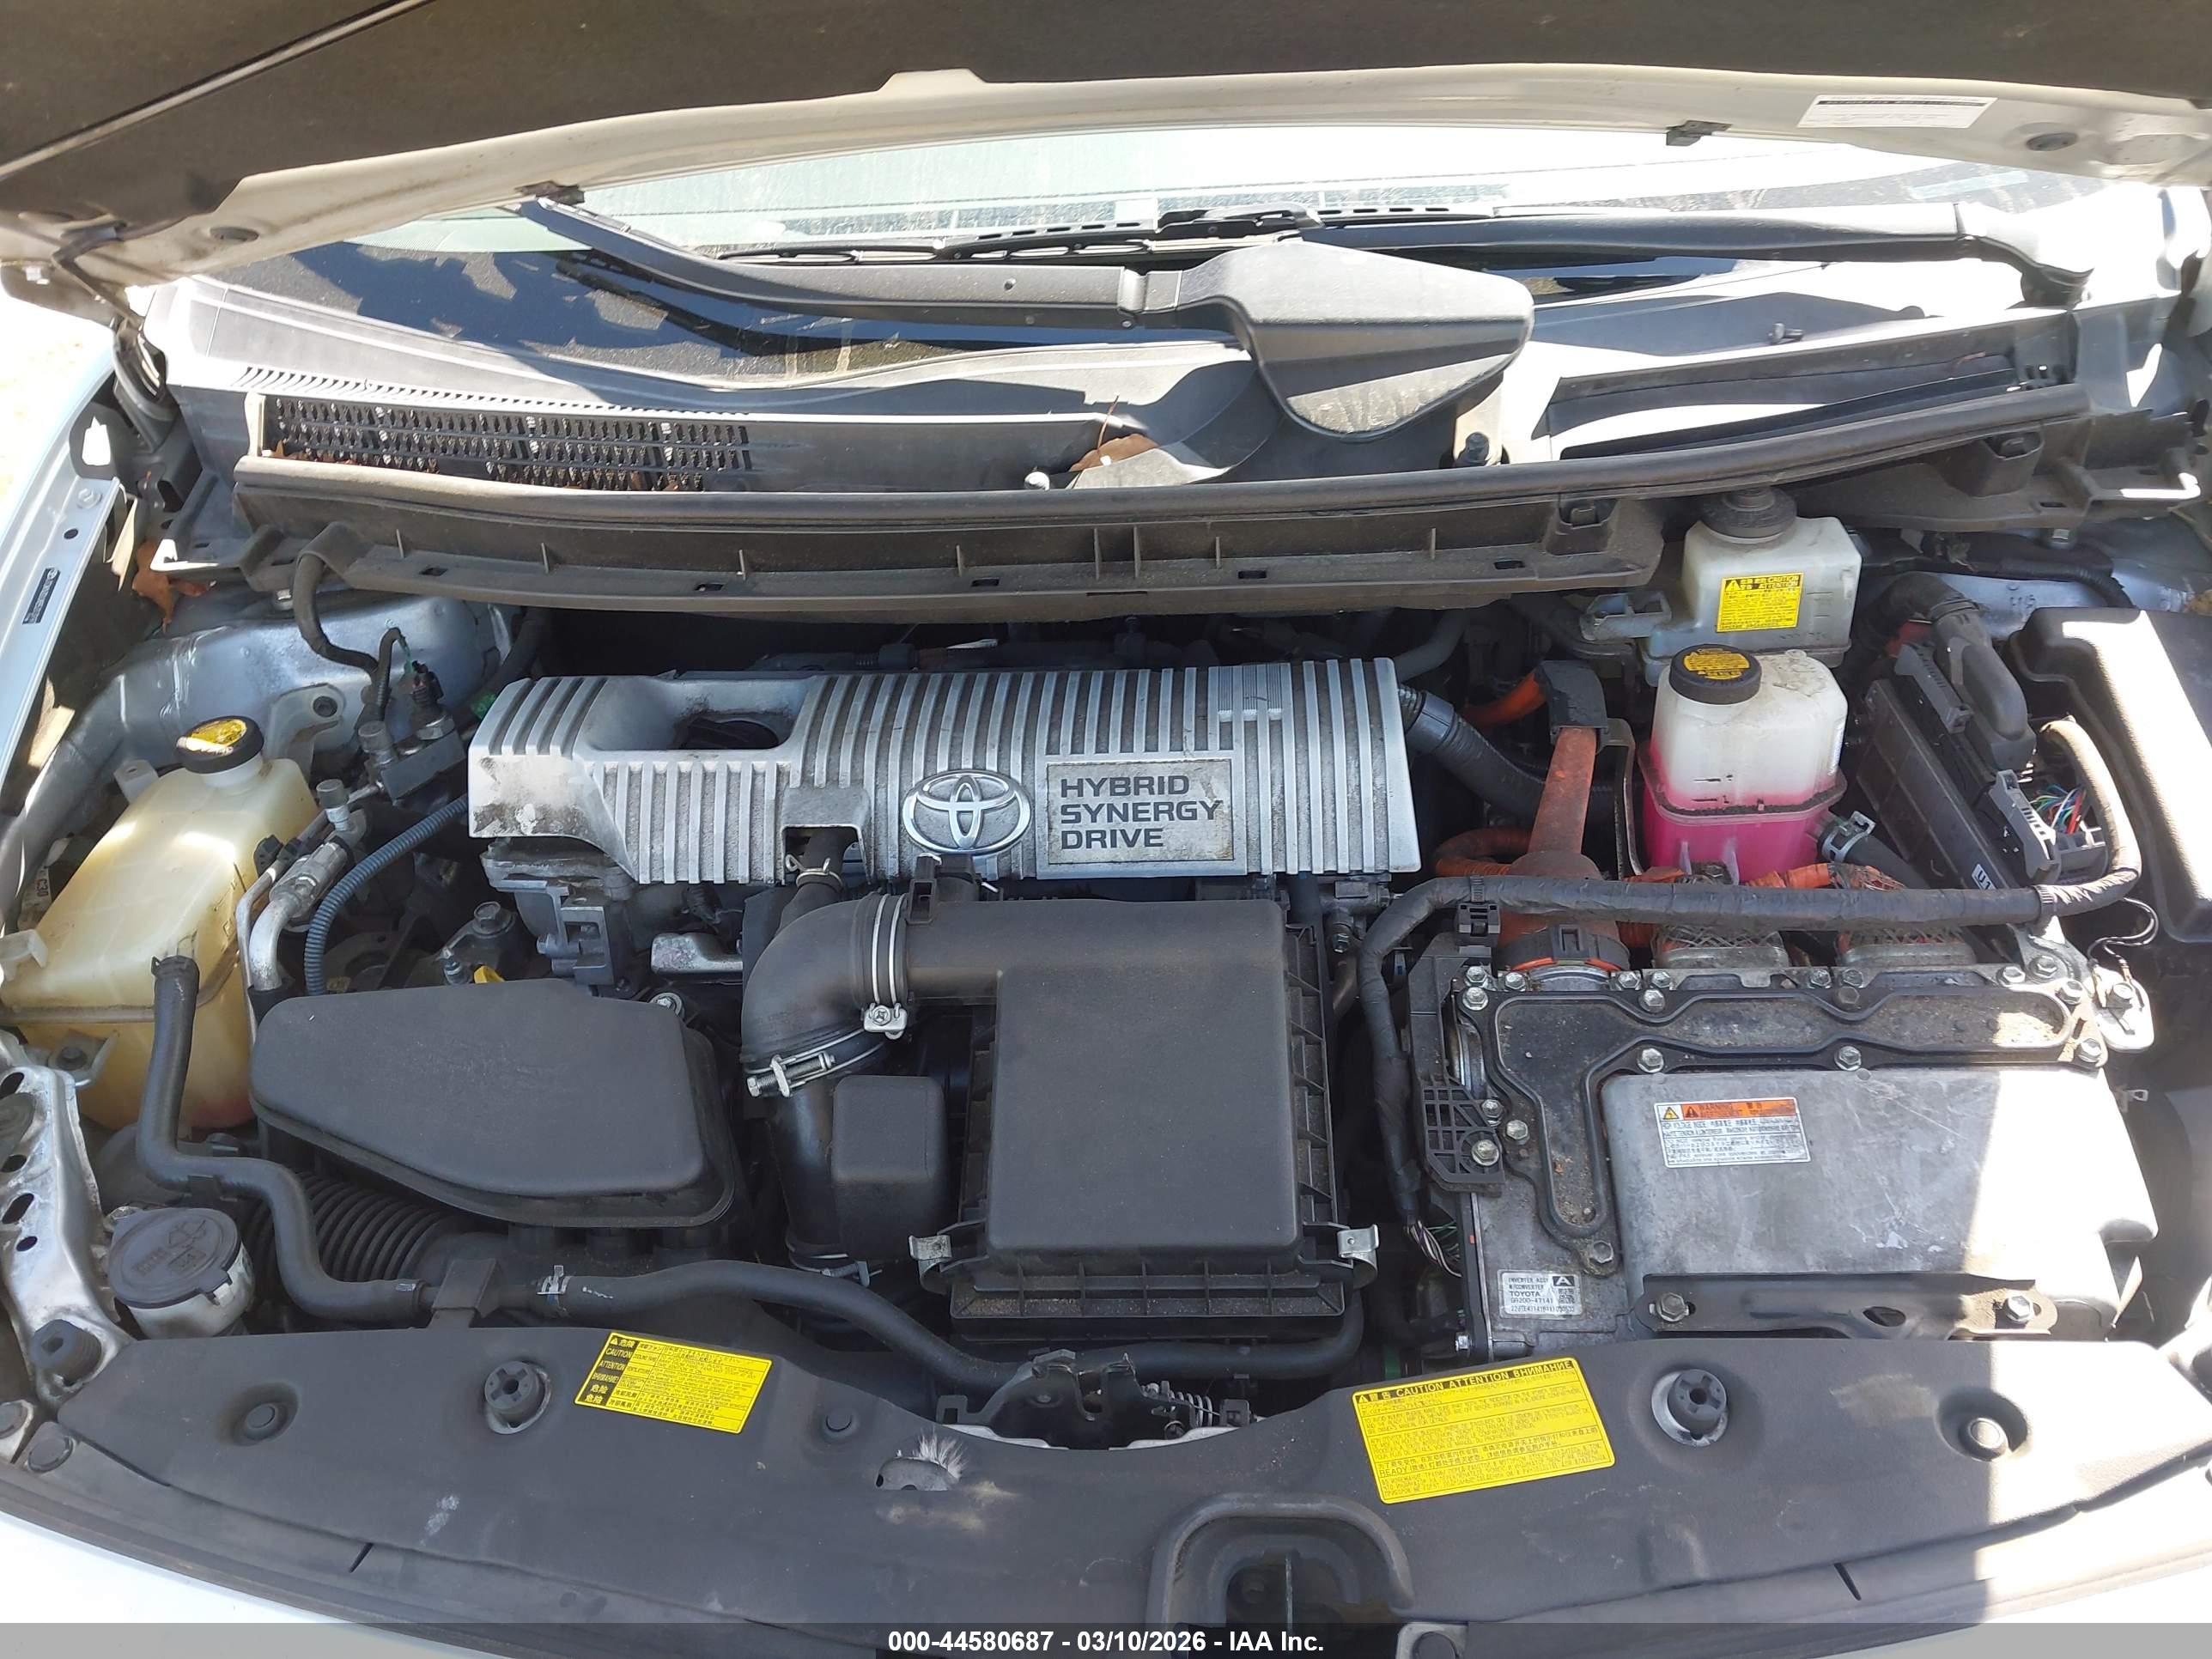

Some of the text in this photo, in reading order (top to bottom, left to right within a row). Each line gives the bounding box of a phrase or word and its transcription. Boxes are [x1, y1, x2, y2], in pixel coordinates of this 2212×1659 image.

[1060, 775, 1190, 798] HYBRID
[1060, 800, 1224, 824] SYNERGY
[1061, 828, 1164, 849] DRIVE
[1555, 1276, 1571, 1285] A
[605, 1347, 633, 1359] CAUTION
[598, 1359, 625, 1372] ATTENTION
[1395, 1382, 1444, 1398] CAUTION
[1449, 1370, 1510, 1389] ATTENTION
[1514, 1360, 1572, 1377] ВНИМАНИЕ
